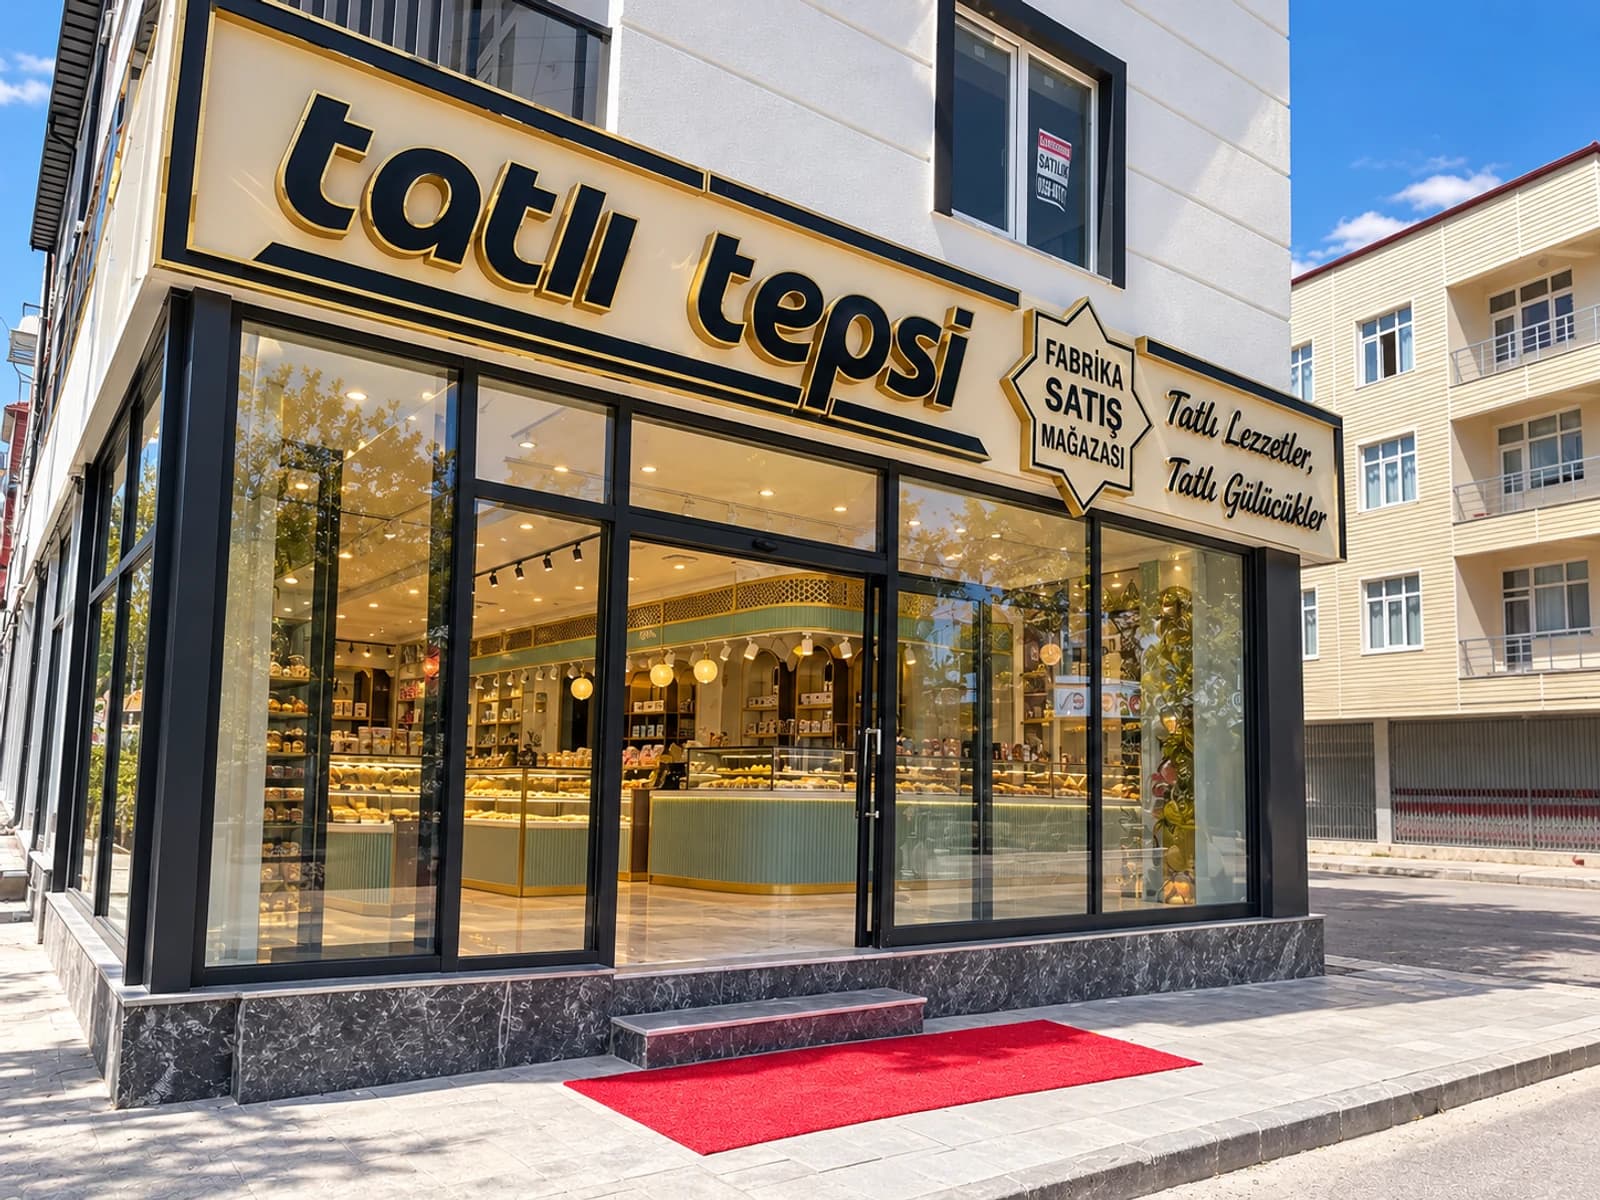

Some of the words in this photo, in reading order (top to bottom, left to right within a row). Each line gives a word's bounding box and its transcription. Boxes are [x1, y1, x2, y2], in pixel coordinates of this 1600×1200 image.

[276, 90, 639, 313] tatlı
[688, 230, 975, 415] tepsi
[1046, 338, 1124, 391] FABRİKA
[1045, 376, 1122, 439] SATIŞ
[1166, 390, 1219, 438] Tatlı
[1224, 410, 1313, 475] Lezzetler,
[1041, 423, 1125, 470] MAĞAZASI
[1166, 457, 1218, 502] Tatlı
[1223, 473, 1327, 531] Gülücükler
